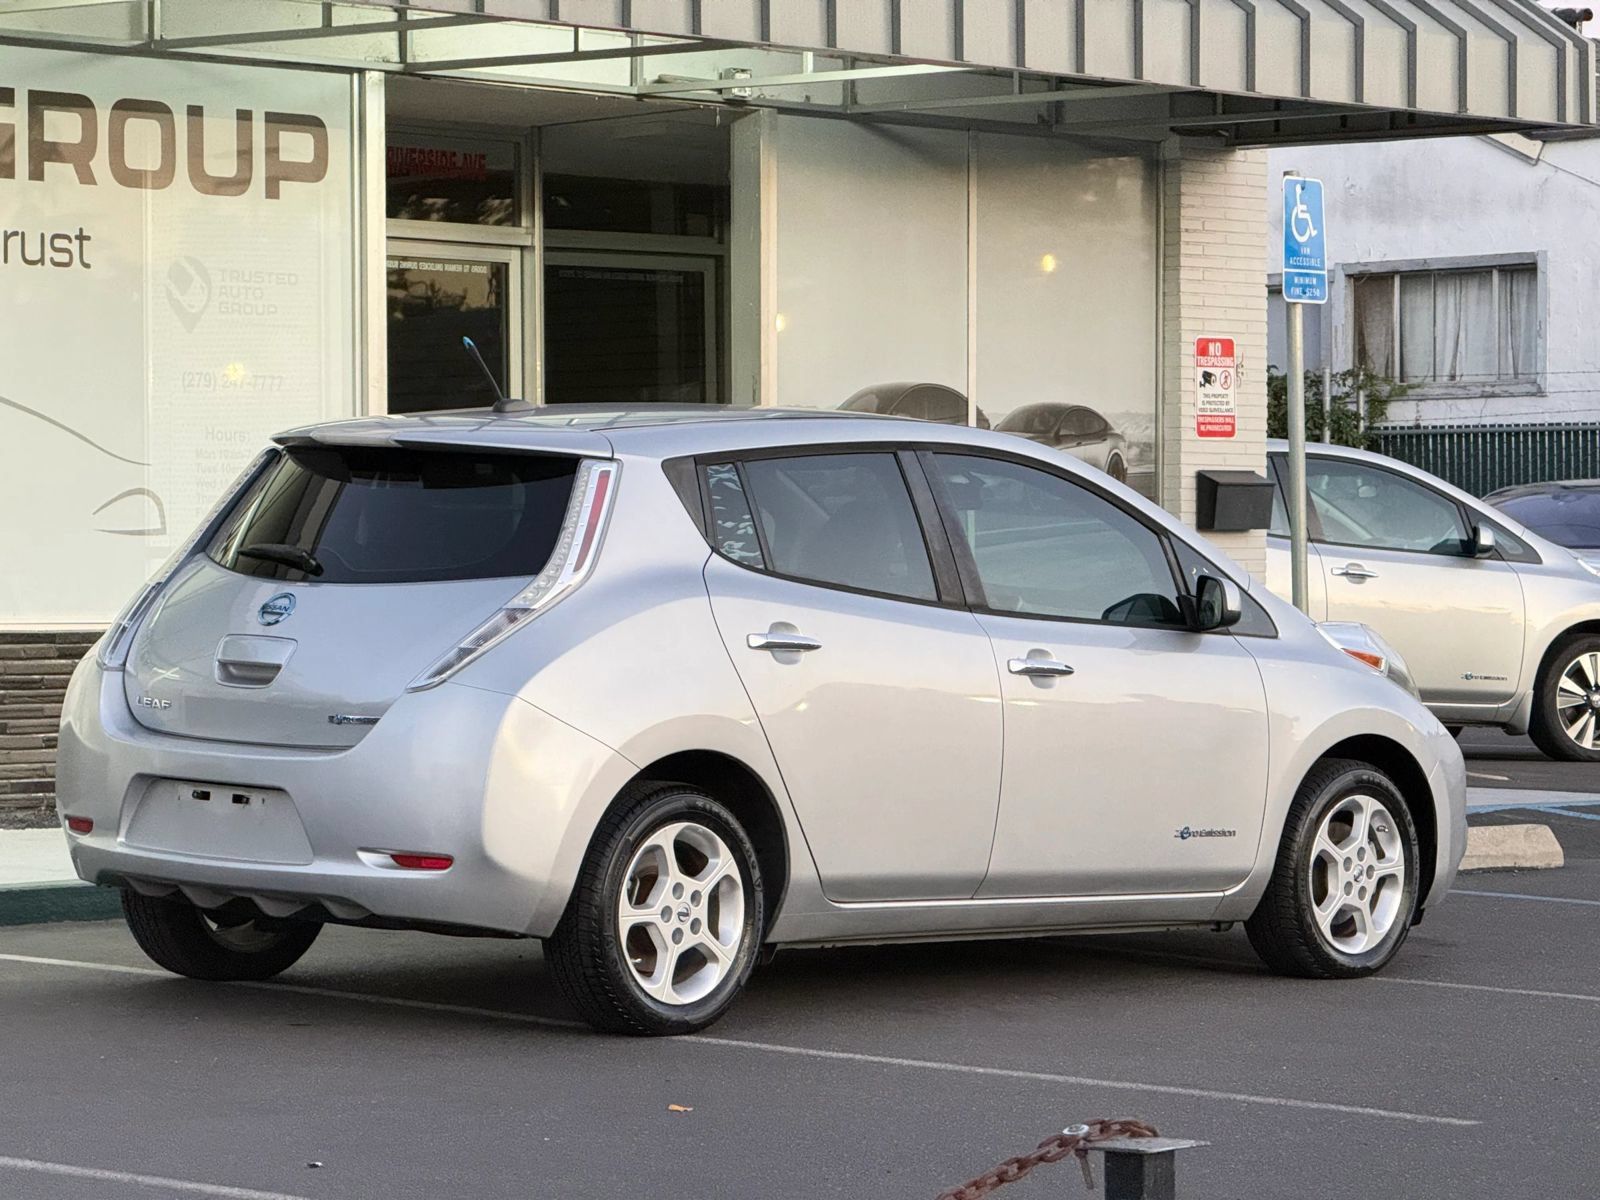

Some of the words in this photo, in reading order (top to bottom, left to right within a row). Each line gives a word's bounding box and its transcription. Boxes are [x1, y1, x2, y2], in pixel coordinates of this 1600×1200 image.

[0, 86, 329, 200] ROUP
[3, 227, 91, 269] rust
[1289, 256, 1321, 267] ACCESSIBLE
[218, 269, 298, 286] TRUSTED
[218, 285, 264, 300] AUTO
[218, 301, 278, 316] GROUP
[1208, 342, 1221, 356] NO
[182, 370, 217, 392] (279)
[136, 695, 171, 710] LEAF
